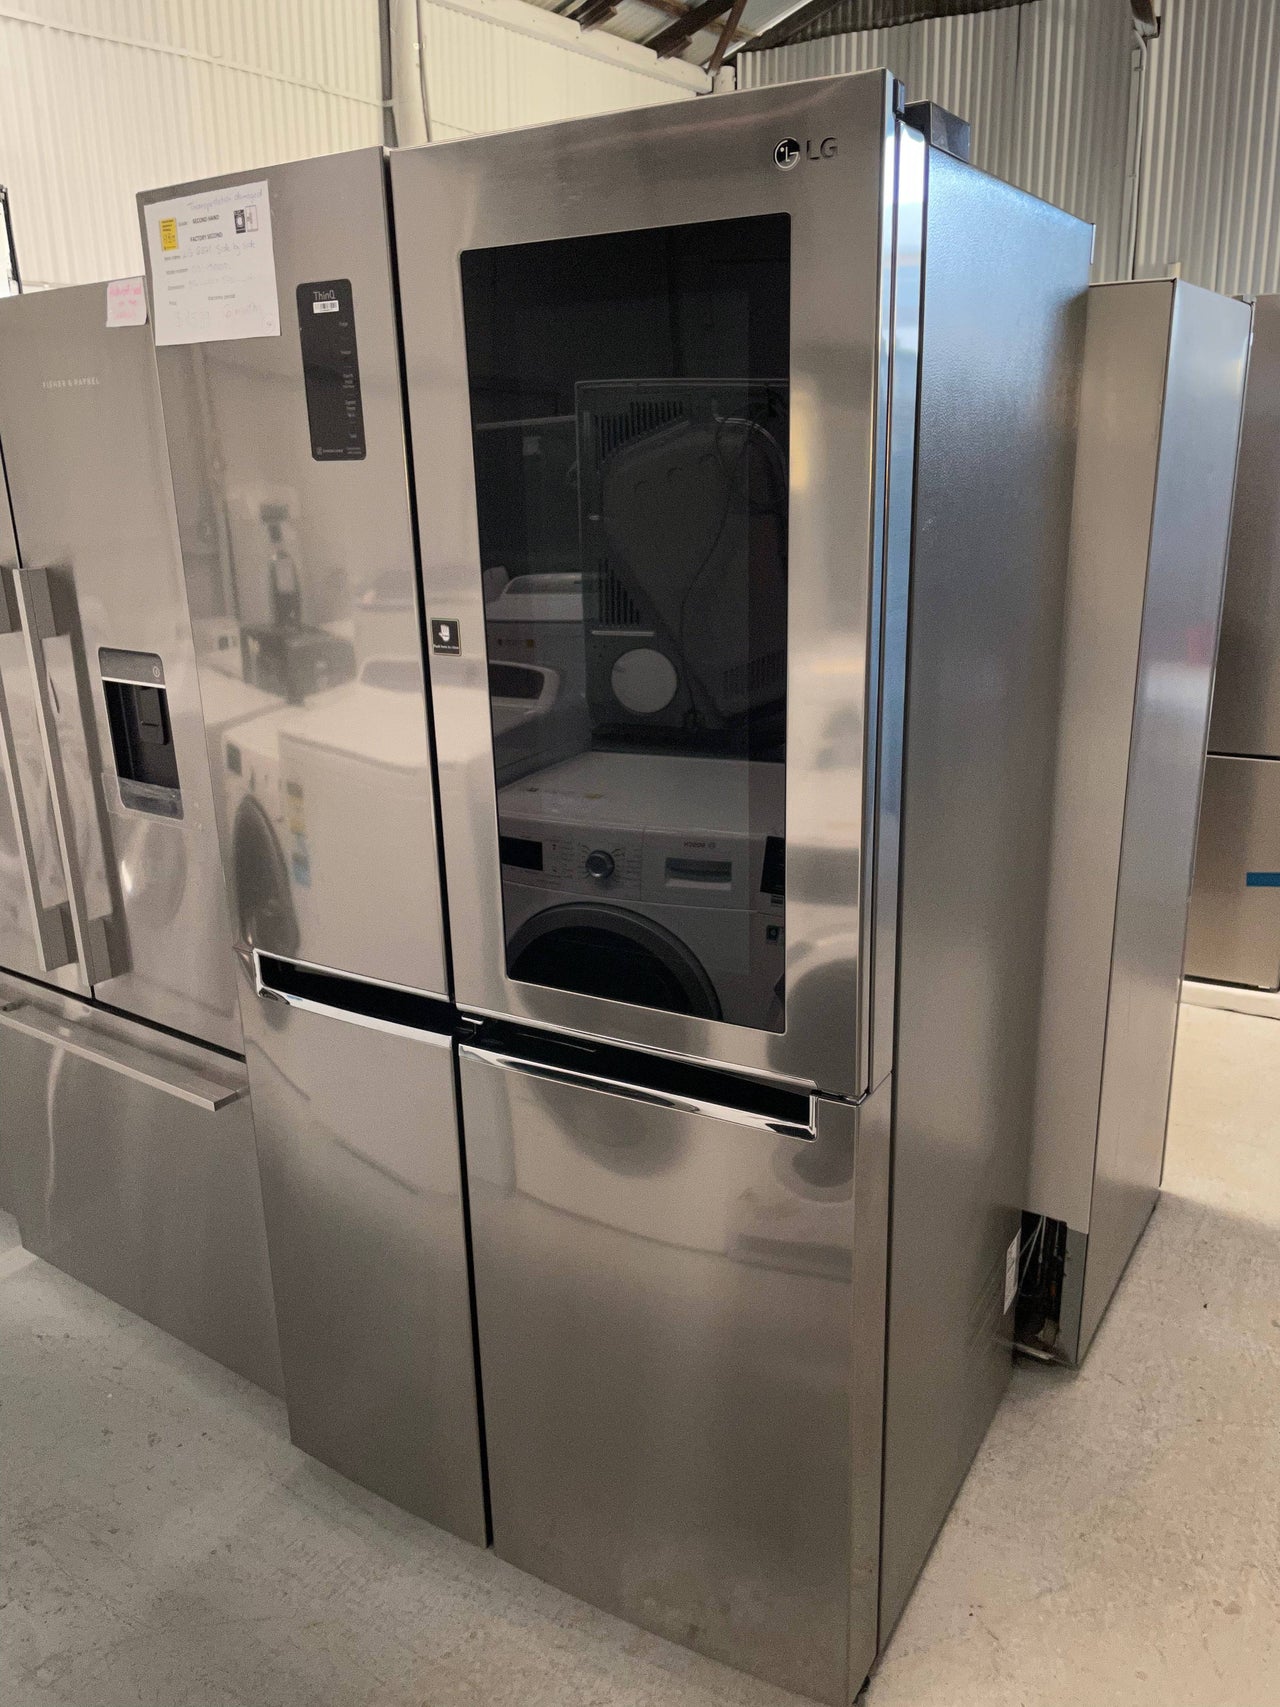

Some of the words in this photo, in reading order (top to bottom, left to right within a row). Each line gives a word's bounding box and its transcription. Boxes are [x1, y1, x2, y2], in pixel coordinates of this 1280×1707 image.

[806, 136, 840, 160] LG
[192, 216, 208, 225] SECOND
[190, 234, 206, 243] FACTORY
[207, 232, 223, 240] SECOND
[313, 289, 336, 301] ThinQ
